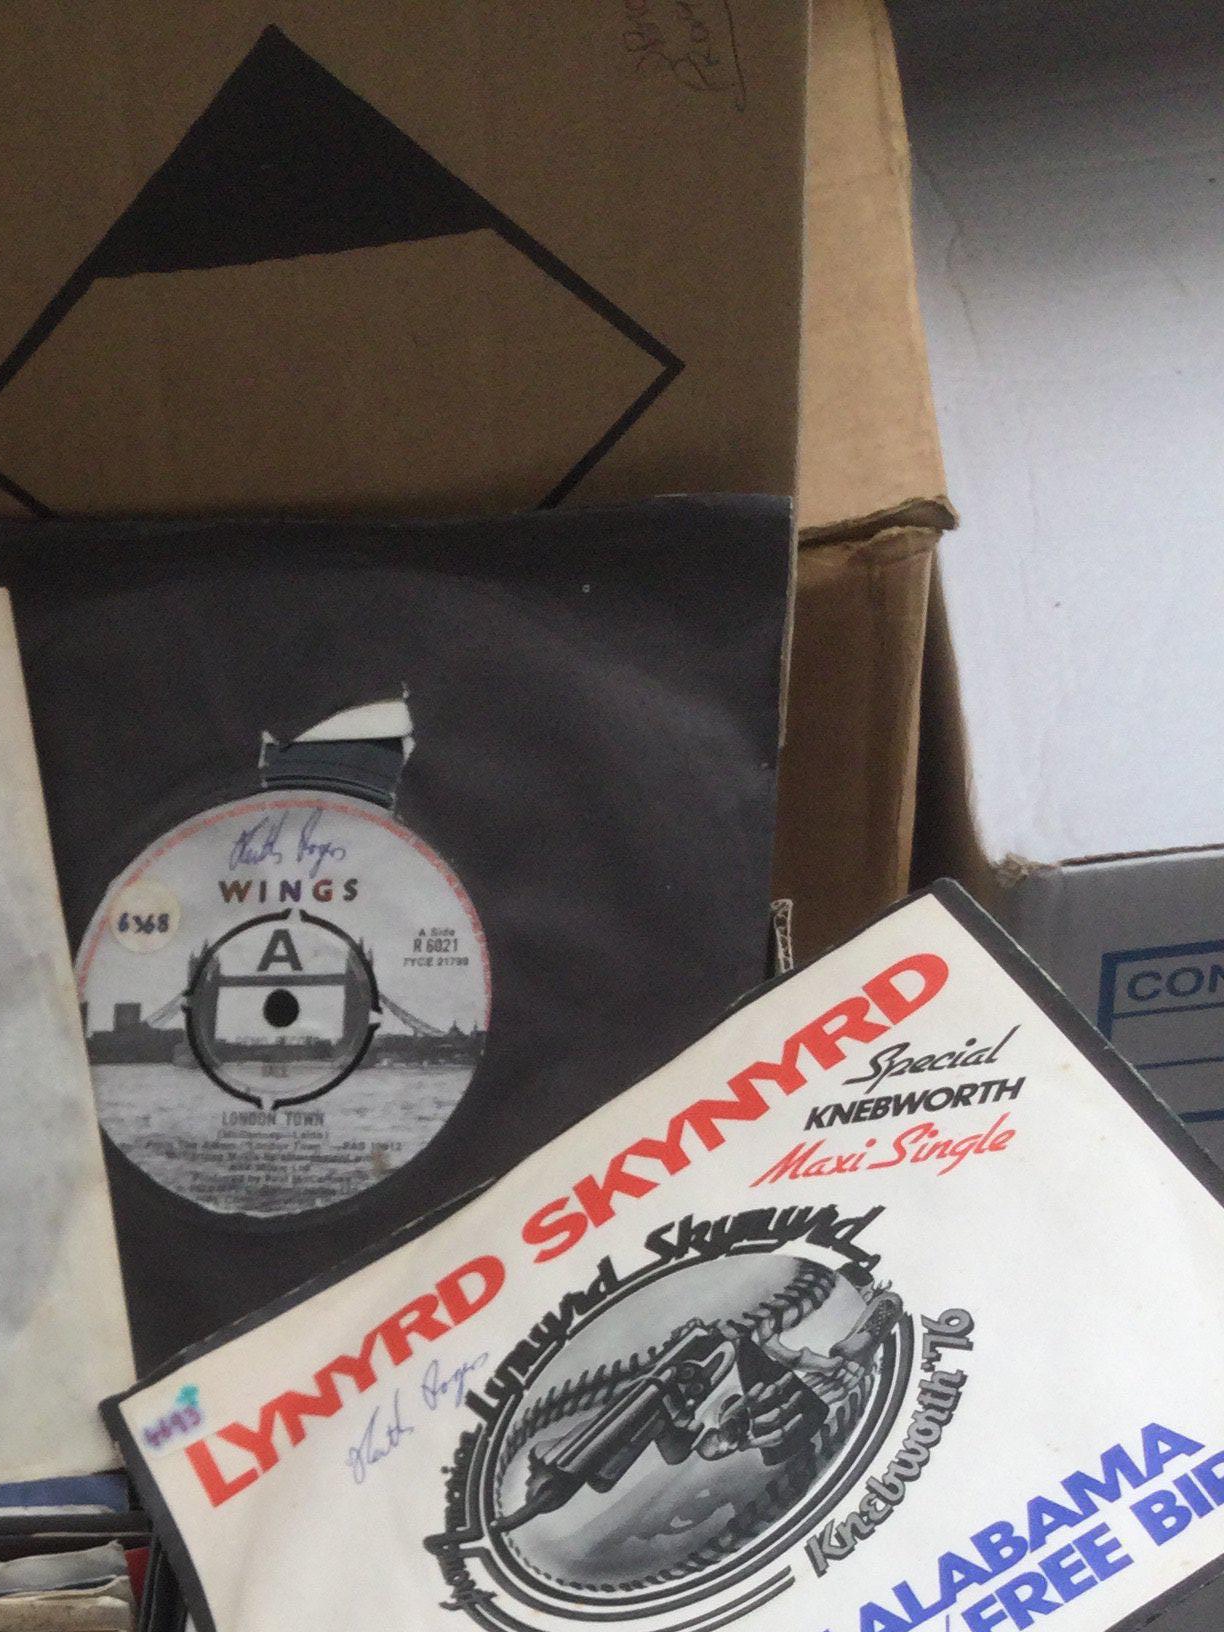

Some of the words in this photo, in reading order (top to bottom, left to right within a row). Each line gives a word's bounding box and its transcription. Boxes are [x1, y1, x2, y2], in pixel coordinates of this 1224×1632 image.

[218, 878, 359, 903] WINGS
[257, 928, 303, 972] A
[841, 1024, 1022, 1095] Special
[221, 1110, 276, 1126] LONDON
[284, 1110, 325, 1126] TOWN
[803, 1076, 1026, 1131] KNEBWORTH
[748, 1138, 878, 1188] Maxi
[866, 1111, 1016, 1176] Single
[185, 1256, 505, 1508] LYNYRD
[522, 953, 949, 1263] SKYNYRD
[804, 1367, 967, 1578] Knebworth
